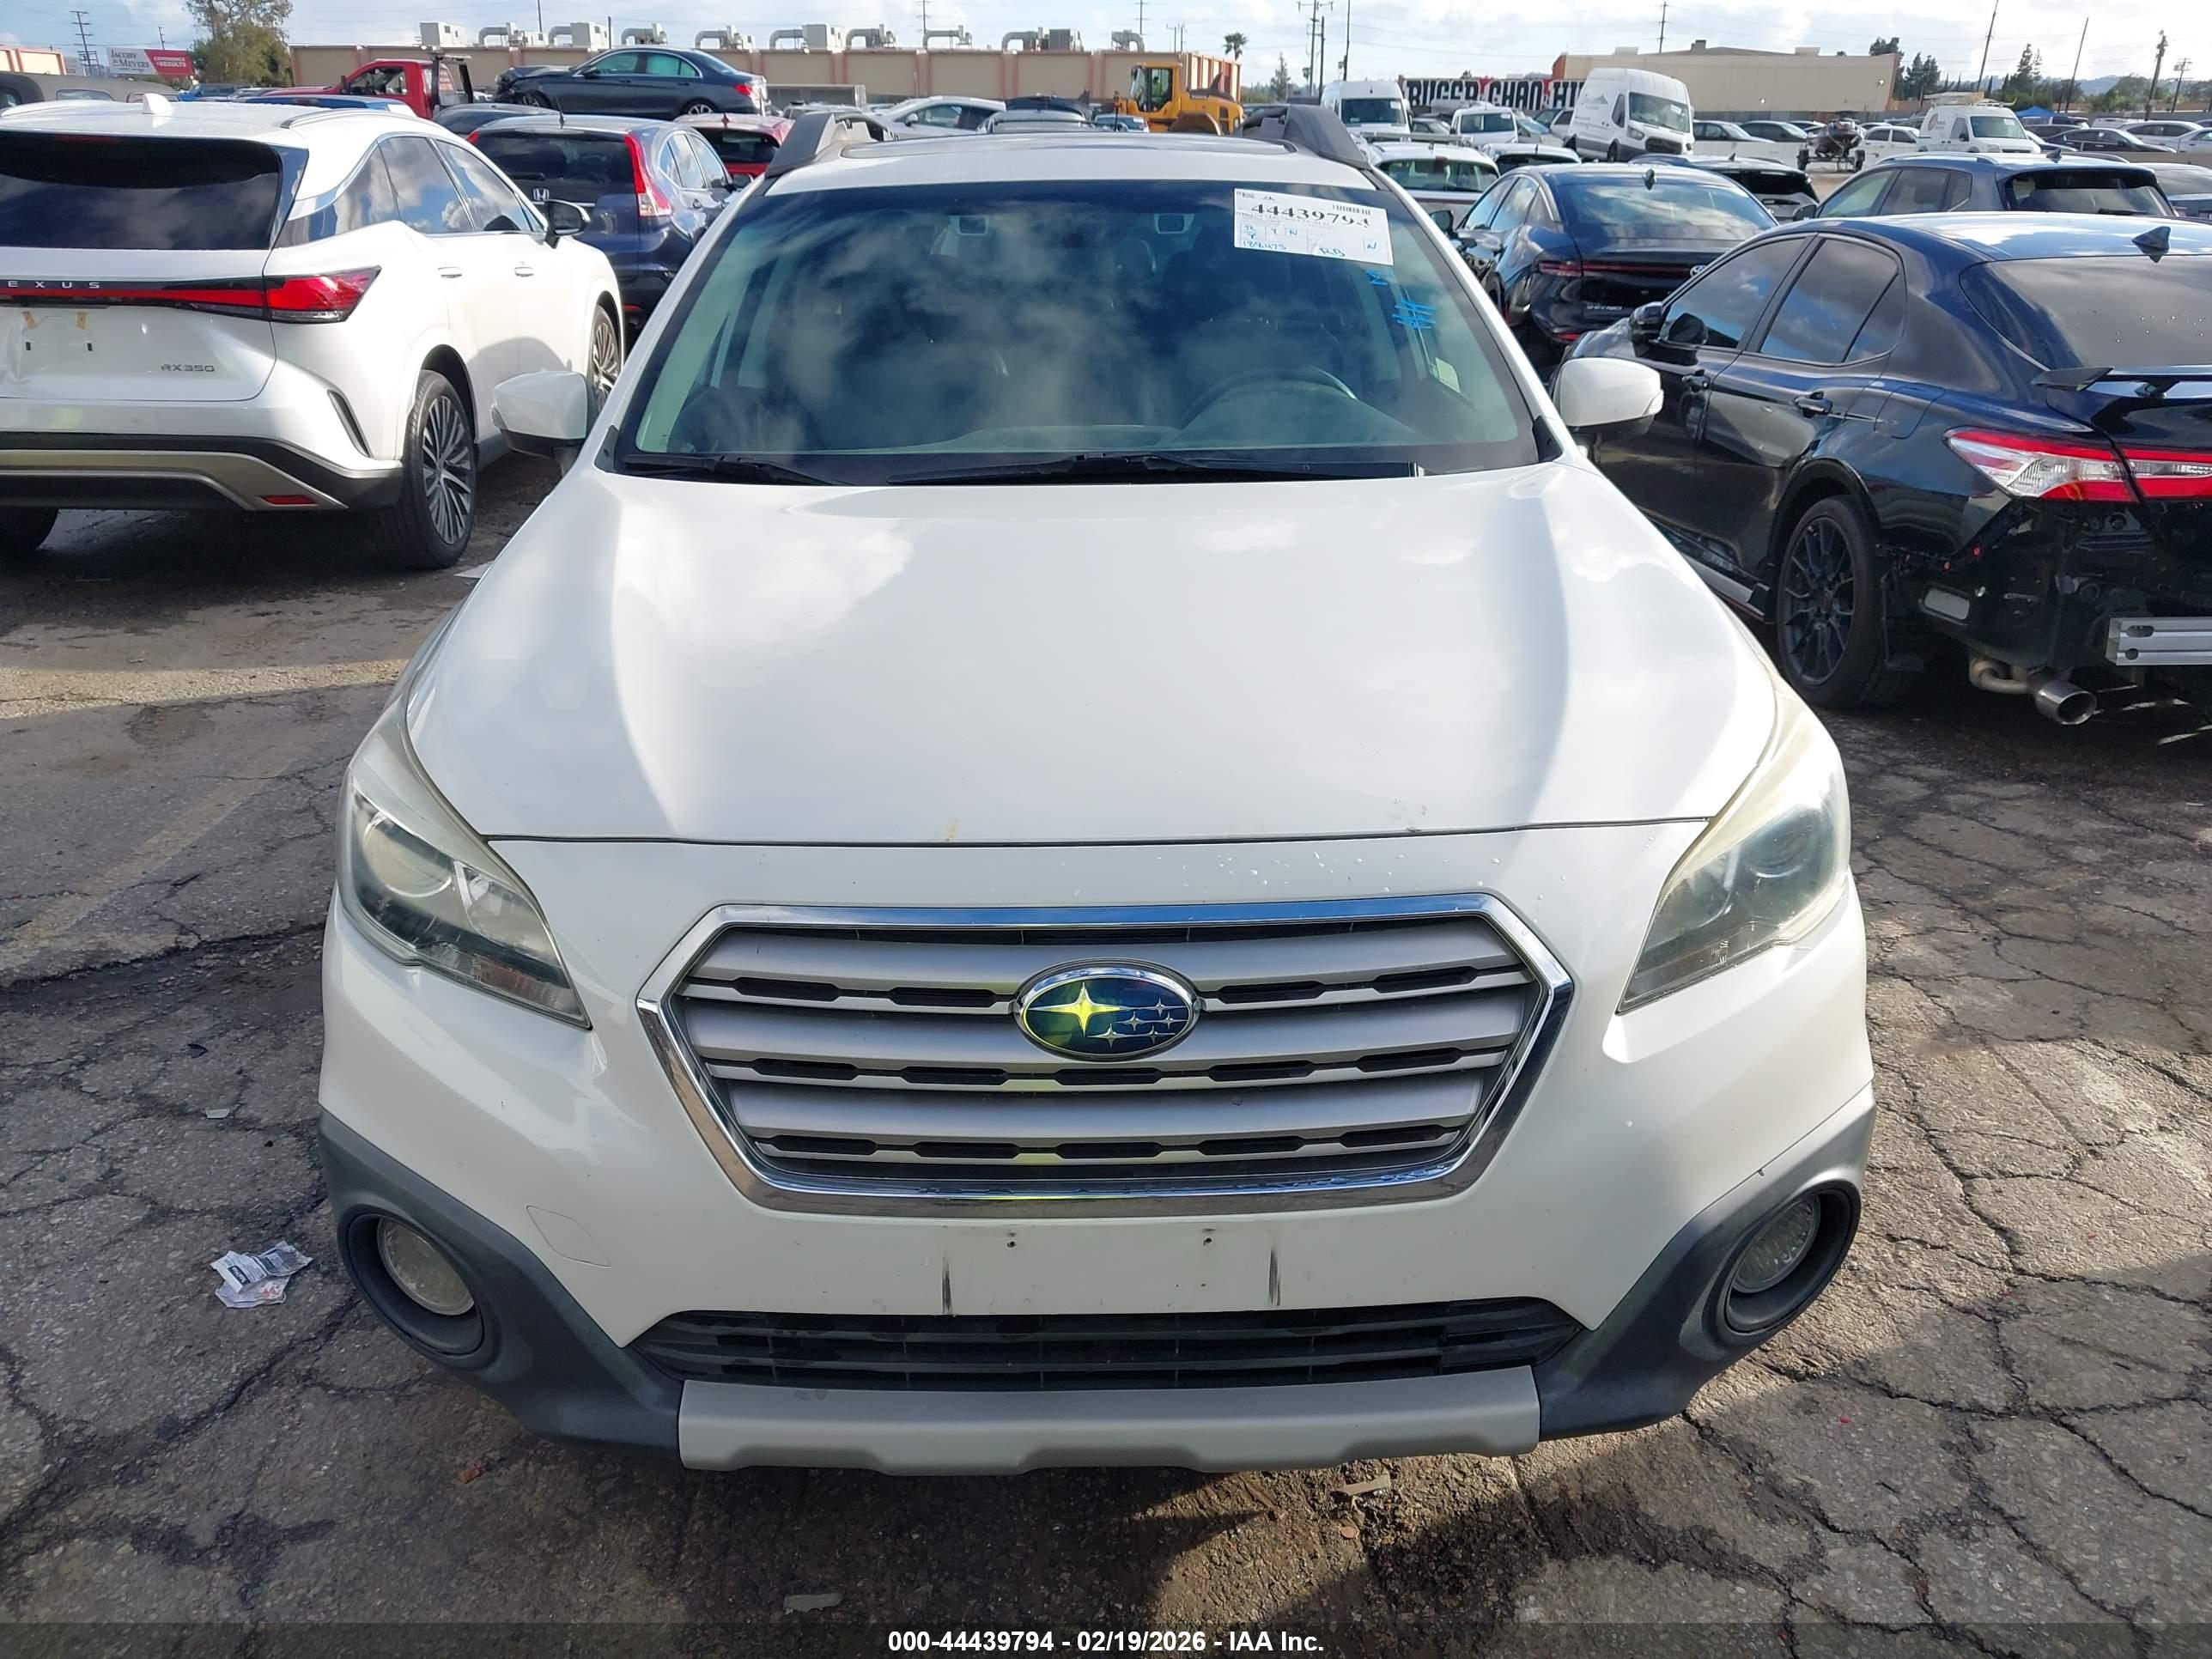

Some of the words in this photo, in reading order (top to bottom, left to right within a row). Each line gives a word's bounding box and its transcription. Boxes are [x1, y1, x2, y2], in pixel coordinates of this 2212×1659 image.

[119, 59, 149, 68] MEYERS
[1250, 204, 1371, 228] 44439794
[161, 363, 216, 373] RX350
